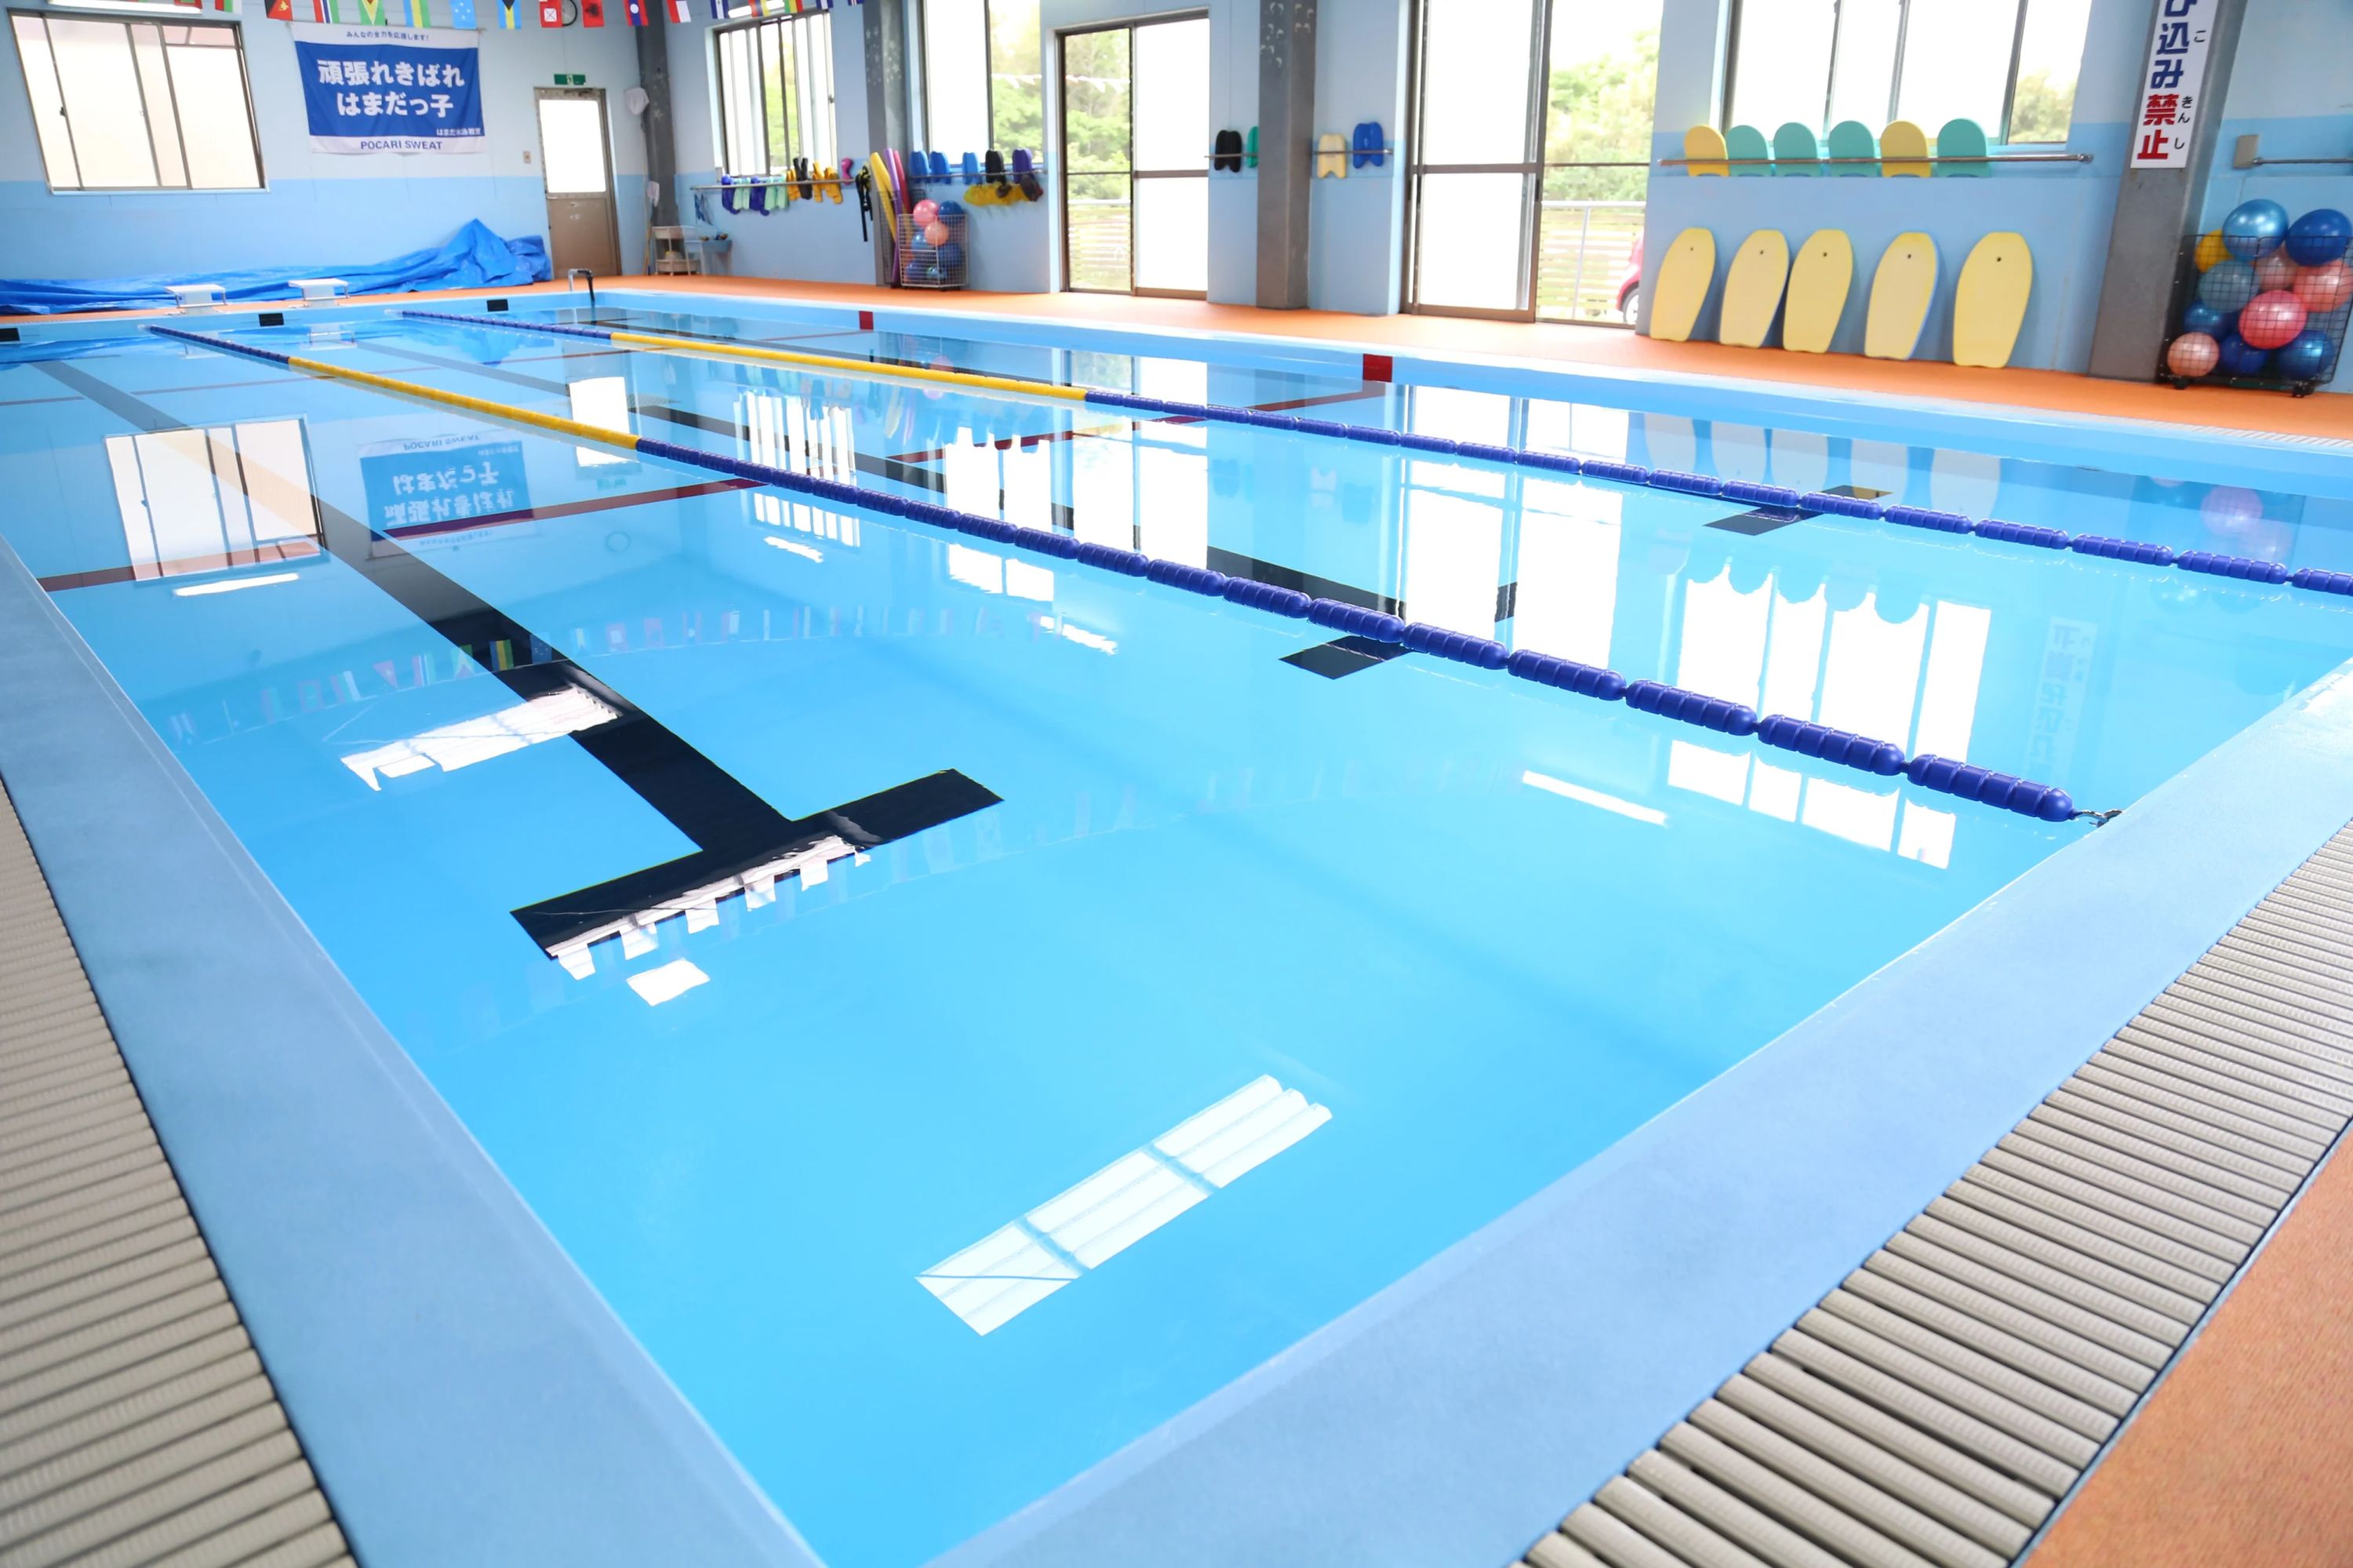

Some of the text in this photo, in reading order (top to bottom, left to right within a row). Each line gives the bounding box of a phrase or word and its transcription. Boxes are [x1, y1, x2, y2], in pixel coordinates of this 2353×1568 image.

[2194, 30, 2206, 42] こ
[317, 60, 465, 88] 頑張れきばれ
[336, 91, 453, 118] はまだっ子
[361, 140, 442, 150] POCARI SWEAT
